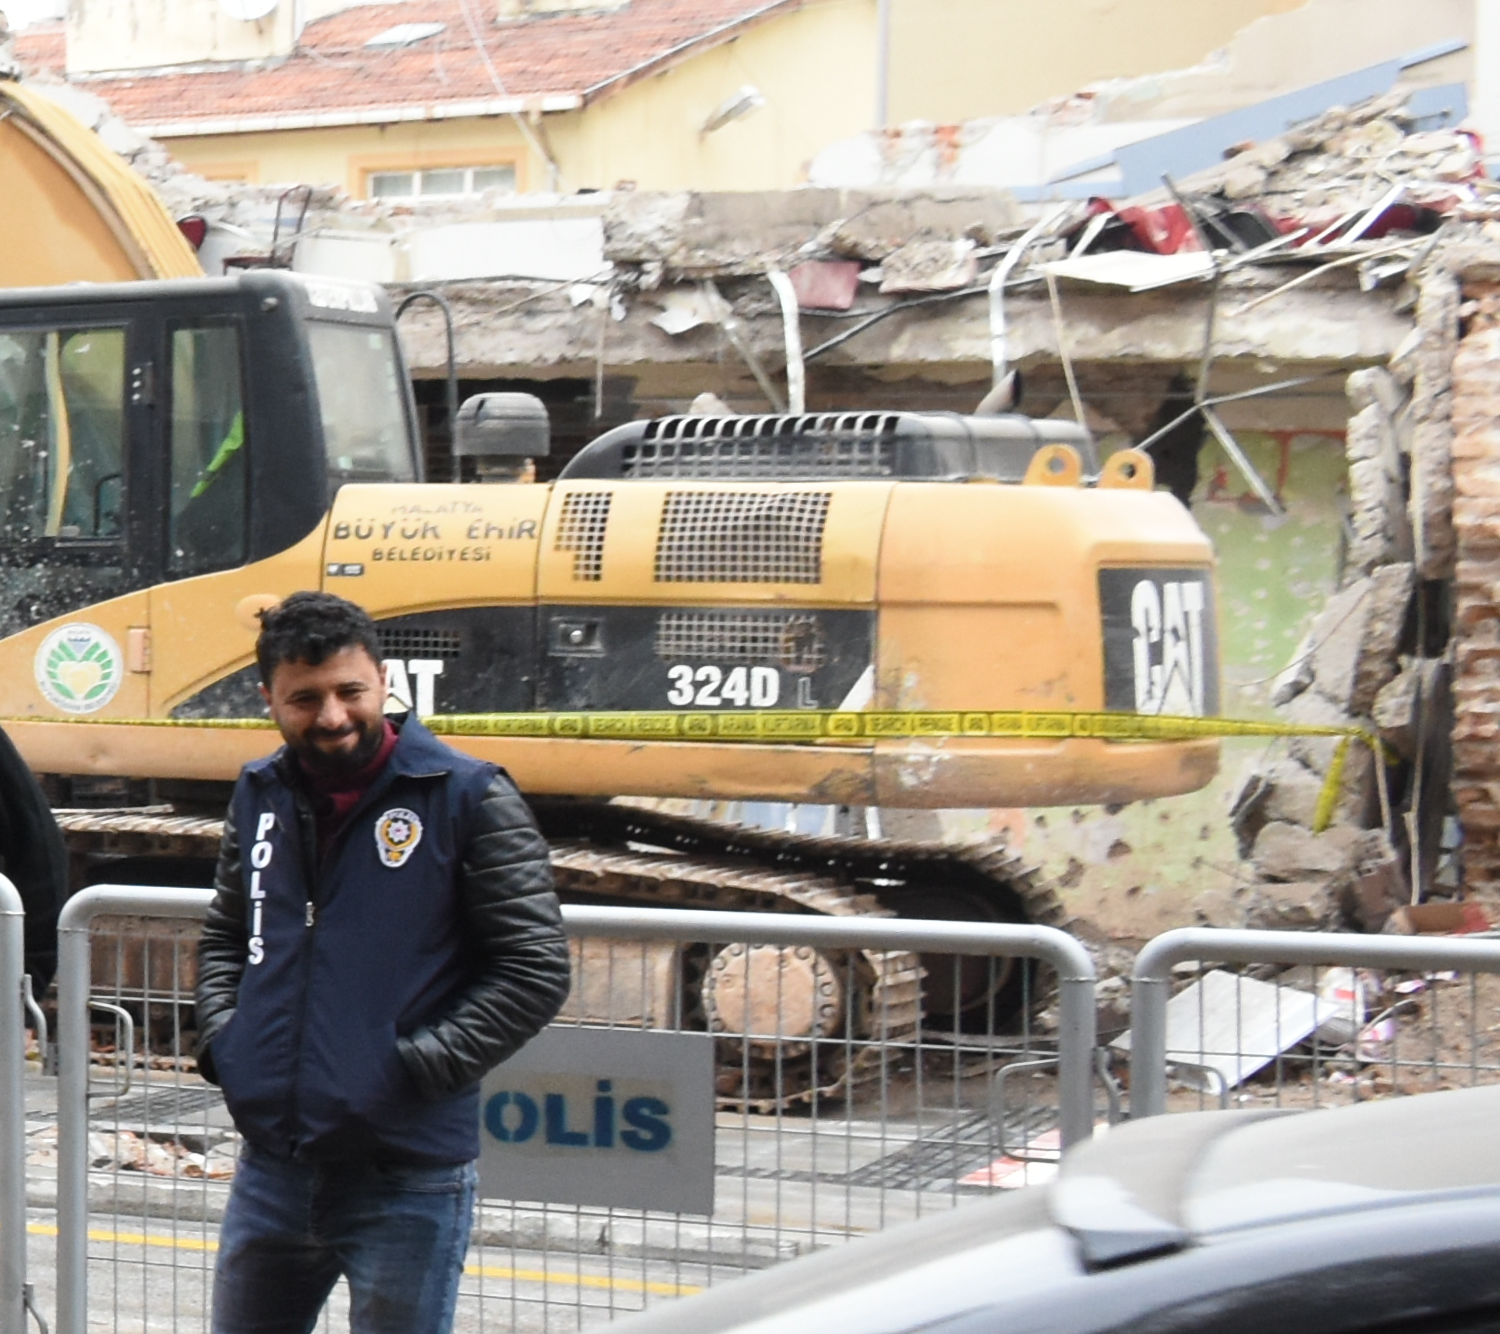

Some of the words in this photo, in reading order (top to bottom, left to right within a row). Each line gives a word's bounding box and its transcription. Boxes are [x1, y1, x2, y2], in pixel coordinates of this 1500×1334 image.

[371, 545, 492, 562] BELEDİYESİ
[1131, 578, 1205, 718] CAT
[384, 659, 443, 716] AT
[667, 665, 780, 707] 324D
[247, 811, 275, 966] POLİS
[483, 1079, 674, 1153] OLİS
